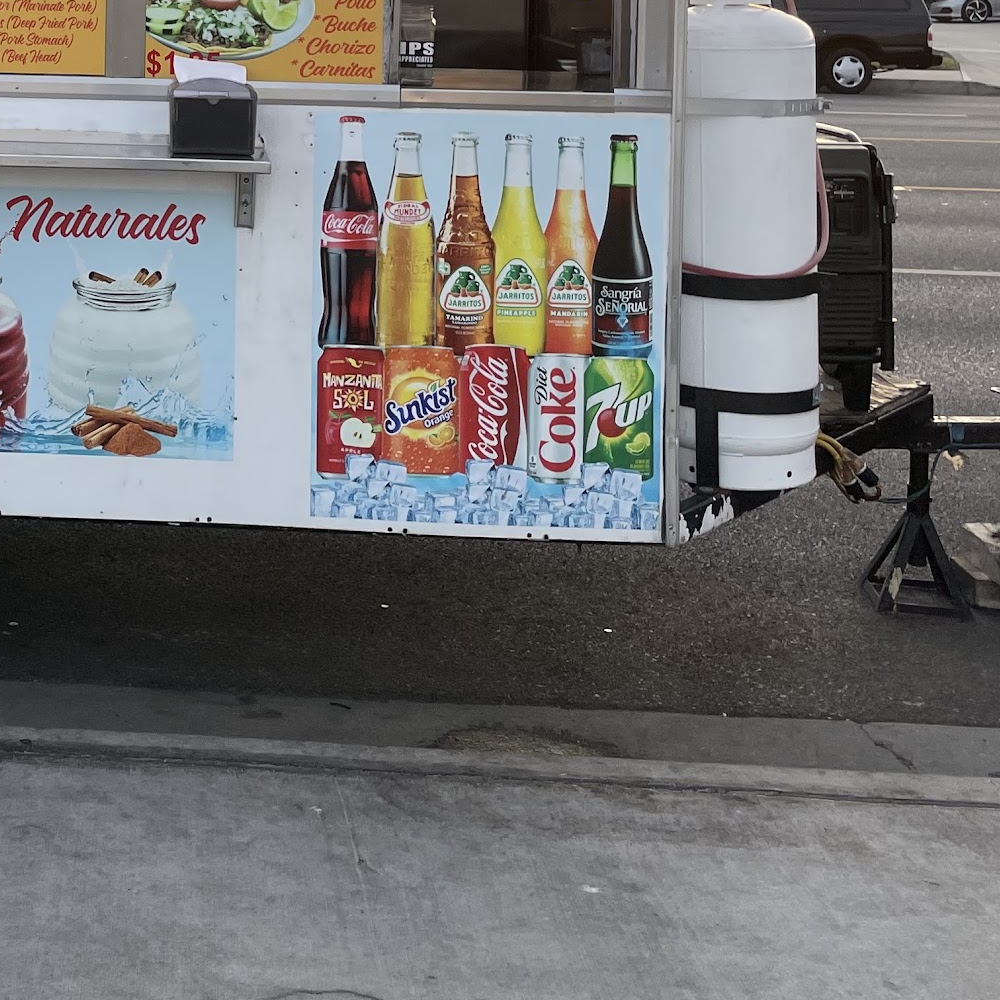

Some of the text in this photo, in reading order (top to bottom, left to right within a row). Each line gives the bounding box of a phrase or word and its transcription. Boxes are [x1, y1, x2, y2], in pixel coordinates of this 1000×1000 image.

[66, 0, 98, 15] Pork)
[6, 15, 37, 31] (Deep
[38, 15, 67, 30] Fried
[67, 16, 99, 32] Pork)
[322, 15, 377, 34] Buche
[26, 32, 74, 48] Stomach)
[305, 37, 376, 56] Chorizo
[399, 41, 435, 56] IPS
[1, 49, 28, 65] (Beef
[29, 50, 62, 65] Head)
[399, 55, 434, 63] PPRECIATED
[299, 59, 376, 79] Carnitas
[6, 194, 207, 246] Naturales
[394, 208, 421, 216] MUNDET
[324, 213, 374, 235] Coca-Cola
[498, 292, 535, 300] JARRITOS
[551, 292, 587, 301] JARRITOS
[600, 285, 642, 303] Sangría
[447, 299, 482, 308] JARRITOS
[595, 298, 648, 316] SEÑORIAL
[445, 313, 484, 322] TAMARIND
[496, 309, 537, 317] PINEAPPLE
[535, 366, 548, 406] Diet
[332, 388, 375, 412] SOL
[384, 376, 457, 436] Sunkist
[468, 351, 508, 460] Coca-Cola
[424, 409, 454, 428] Orange
[538, 367, 577, 473] Coke
